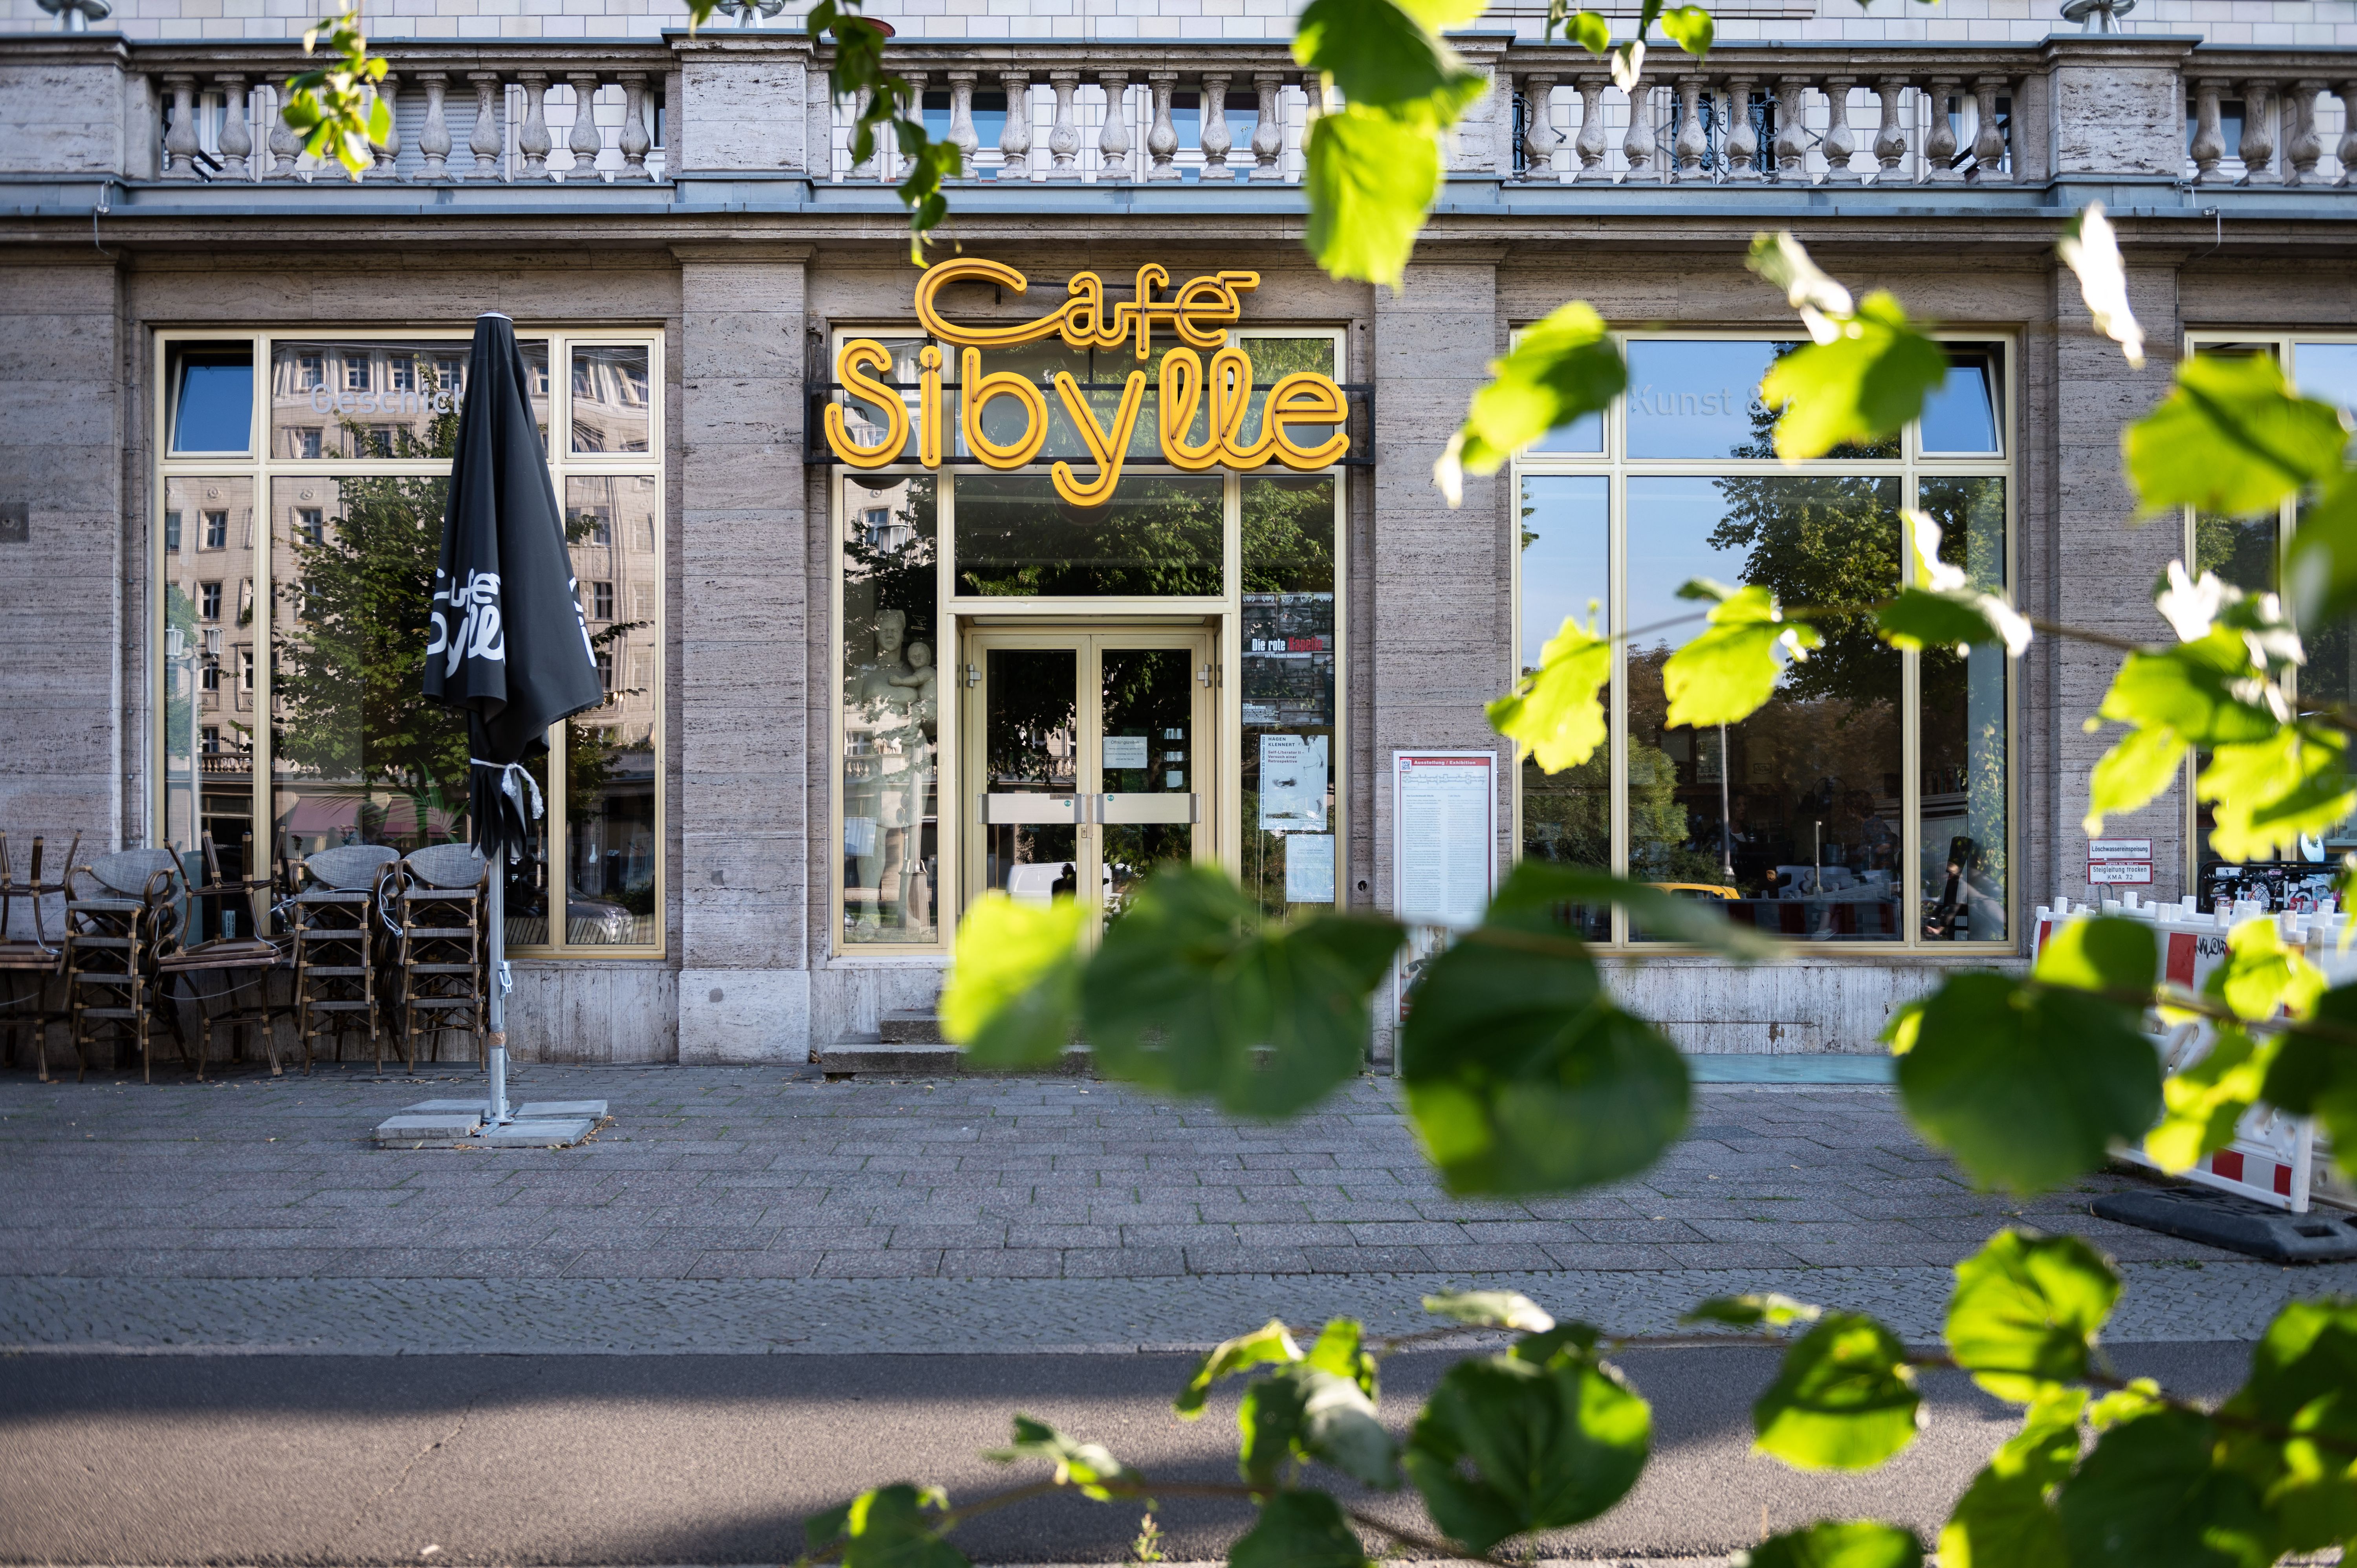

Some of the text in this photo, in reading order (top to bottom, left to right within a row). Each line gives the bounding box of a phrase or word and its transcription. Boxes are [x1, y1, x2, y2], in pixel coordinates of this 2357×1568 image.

[915, 258, 1260, 365] Café
[311, 383, 464, 414] Geschich
[1630, 384, 1733, 415] Kunst
[1746, 384, 1772, 415] &
[824, 339, 1349, 509] Sibylle
[1252, 636, 1323, 653] Die rote Kapelle
